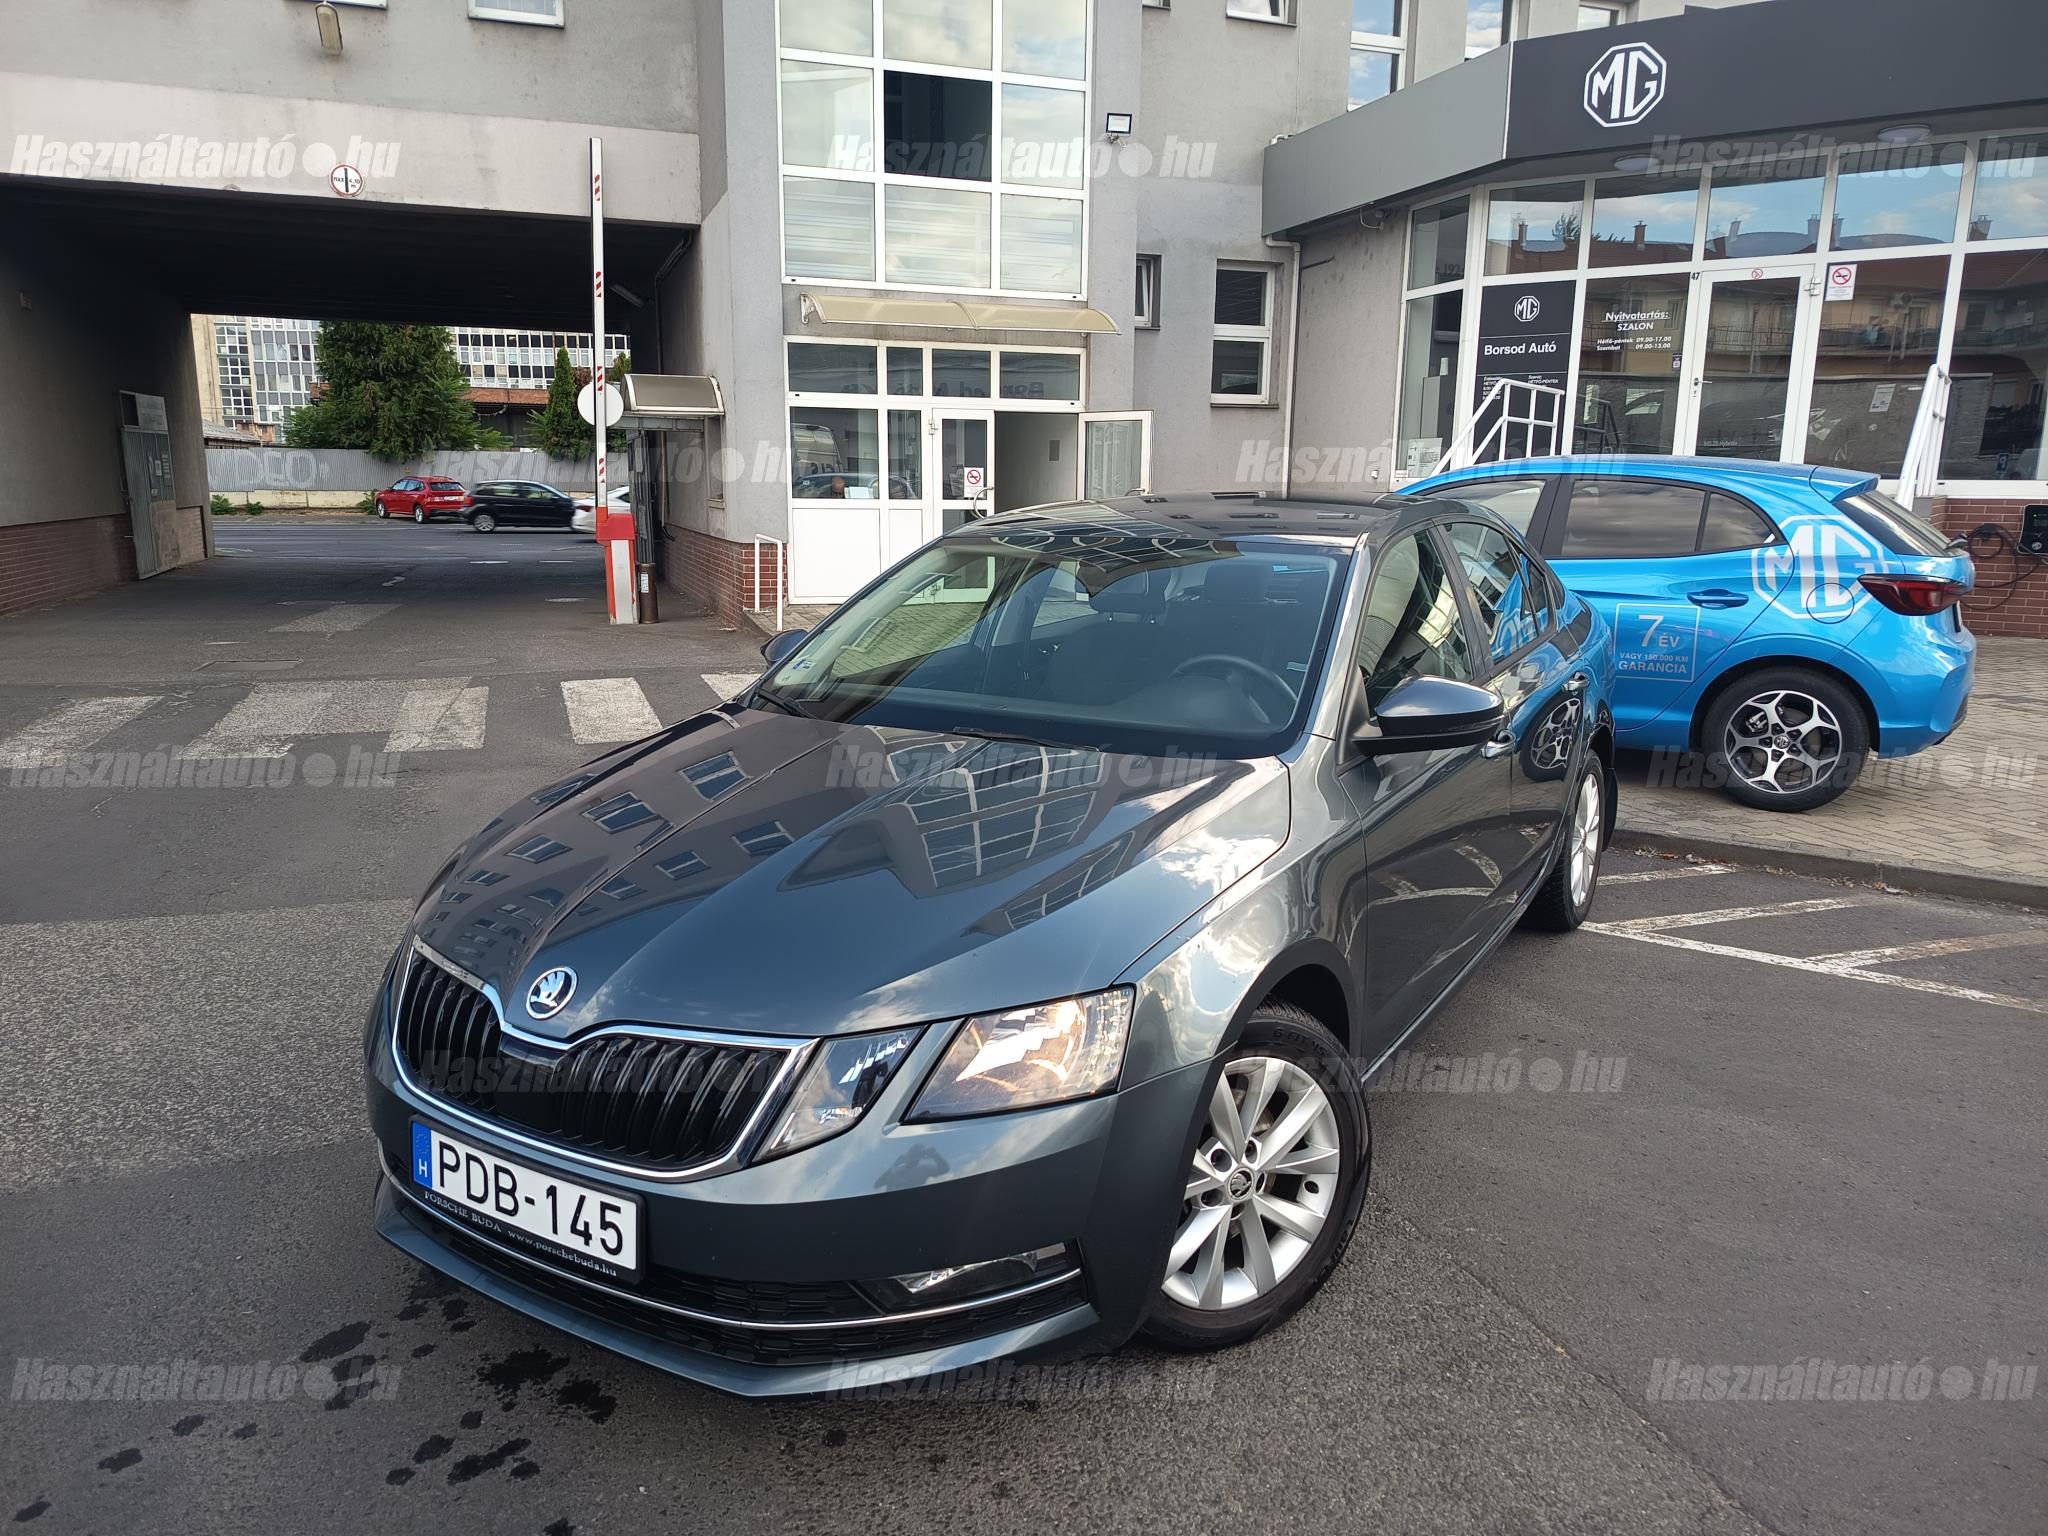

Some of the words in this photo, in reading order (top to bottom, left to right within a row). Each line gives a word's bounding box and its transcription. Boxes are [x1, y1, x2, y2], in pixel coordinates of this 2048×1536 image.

[1592, 50, 1659, 120] MG
[1691, 272, 1700, 281] 47
[1516, 298, 1538, 320] MG
[1617, 322, 1654, 331] SZALON
[1484, 343, 1526, 355] Borsod
[1528, 341, 1557, 353] Autó
[1765, 525, 1875, 608] MG
[1639, 614, 1664, 648] 7
[1658, 632, 1680, 648] ÉV
[1618, 660, 1687, 674] GARANCIA
[1620, 651, 1642, 660] VAGY
[1675, 655, 1689, 663] KM
[418, 1158, 428, 1178] H
[438, 1140, 623, 1256] PDB-145
[424, 1190, 468, 1218] PORSCHE
[471, 1209, 502, 1233] BUDA
[507, 1230, 617, 1277] www.porschebuda.hu
